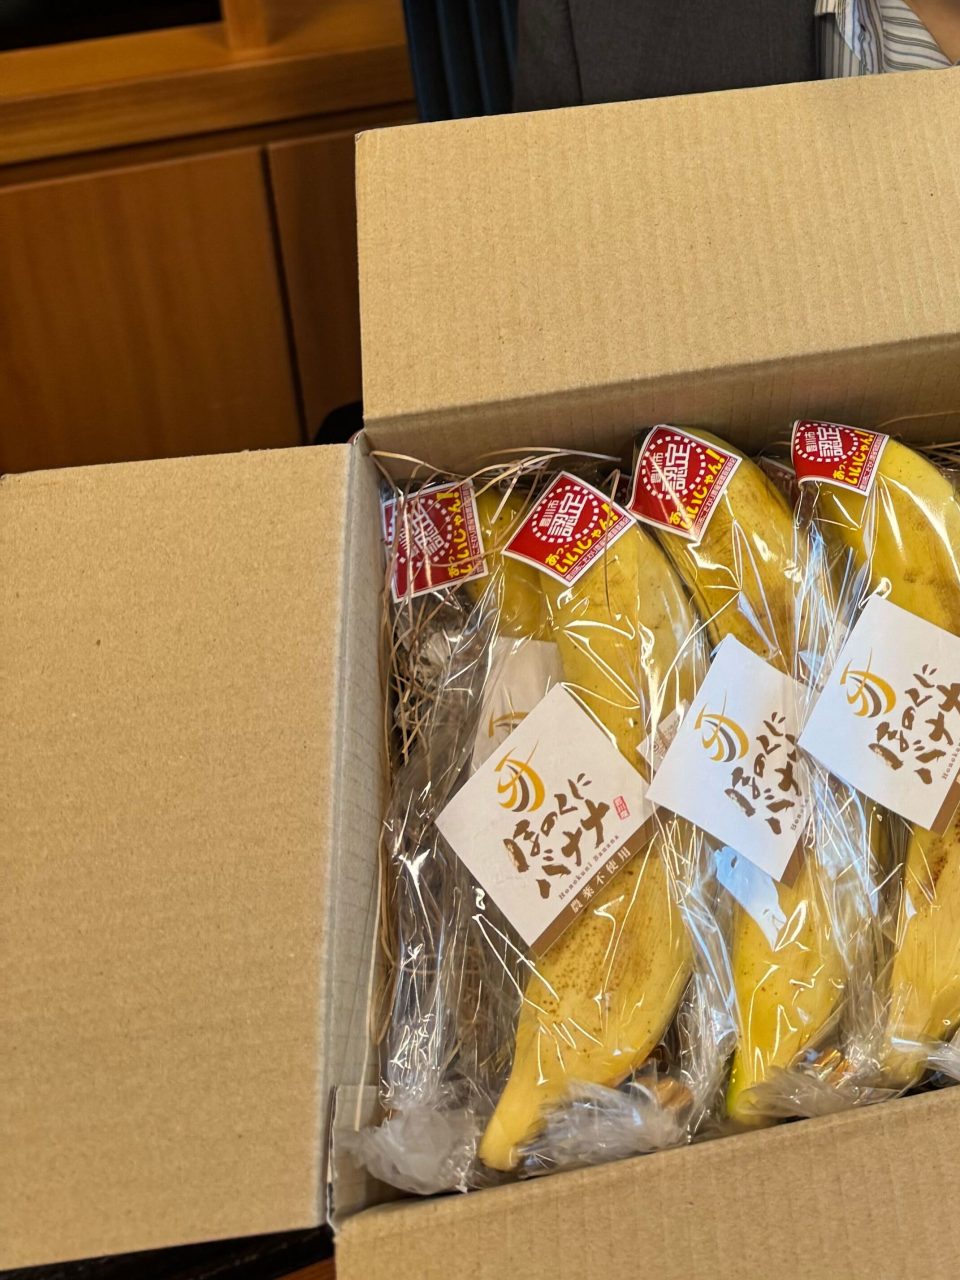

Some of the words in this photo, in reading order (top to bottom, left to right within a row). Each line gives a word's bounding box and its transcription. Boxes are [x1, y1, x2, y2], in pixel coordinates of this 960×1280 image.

[816, 427, 844, 457] 認定
[662, 443, 691, 491] 認定
[547, 492, 589, 537] 認定
[536, 799, 611, 899] バナナ
[569, 846, 632, 914] 農薬不使用
